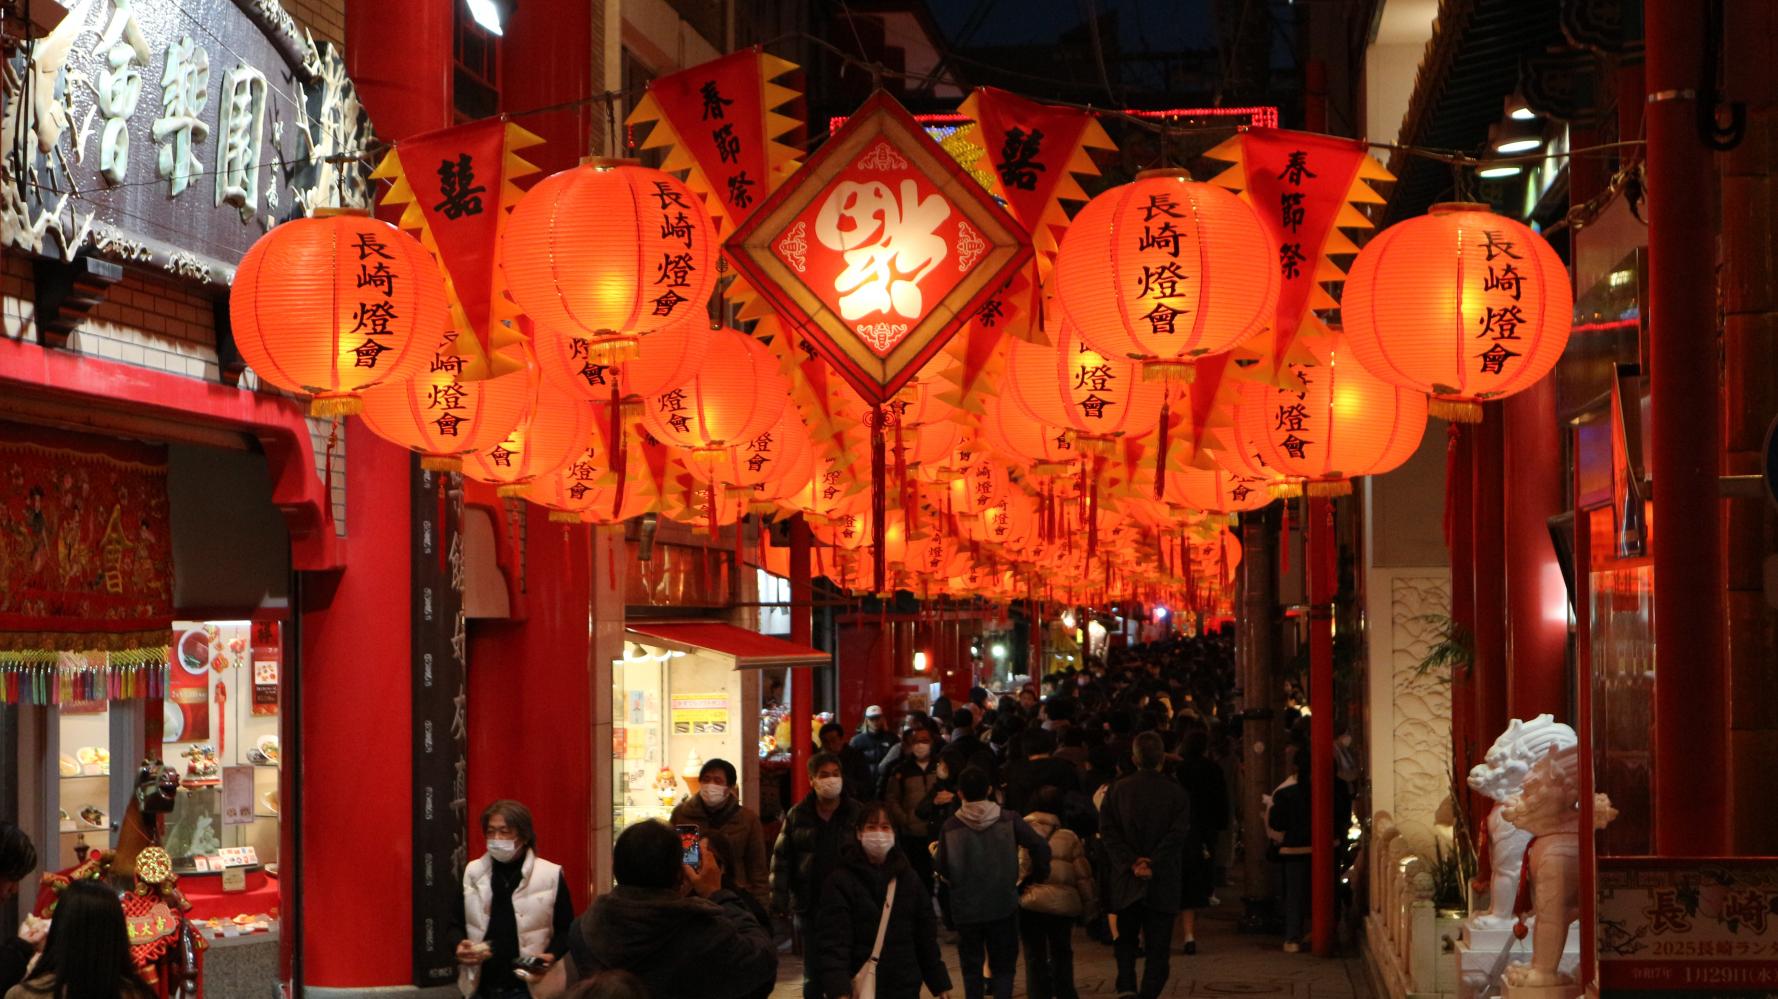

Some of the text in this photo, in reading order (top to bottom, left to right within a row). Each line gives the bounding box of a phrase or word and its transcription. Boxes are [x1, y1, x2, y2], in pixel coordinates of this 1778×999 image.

[699, 80, 755, 208] 春節祭
[648, 180, 697, 318] 長崎燈會
[1278, 150, 1317, 280] 春節祭
[349, 232, 400, 369] 長崎燈會
[1137, 193, 1190, 335] 長崎燈會
[1476, 229, 1529, 375] 長崎燈會
[657, 388, 694, 433] 燈會
[1074, 342, 1117, 419] 燈會
[486, 438, 520, 468] 會
[568, 448, 598, 500] 燈會
[822, 457, 841, 500] 燈會
[976, 461, 993, 506] 崎燈會
[1647, 889, 1769, 934] 長崎
